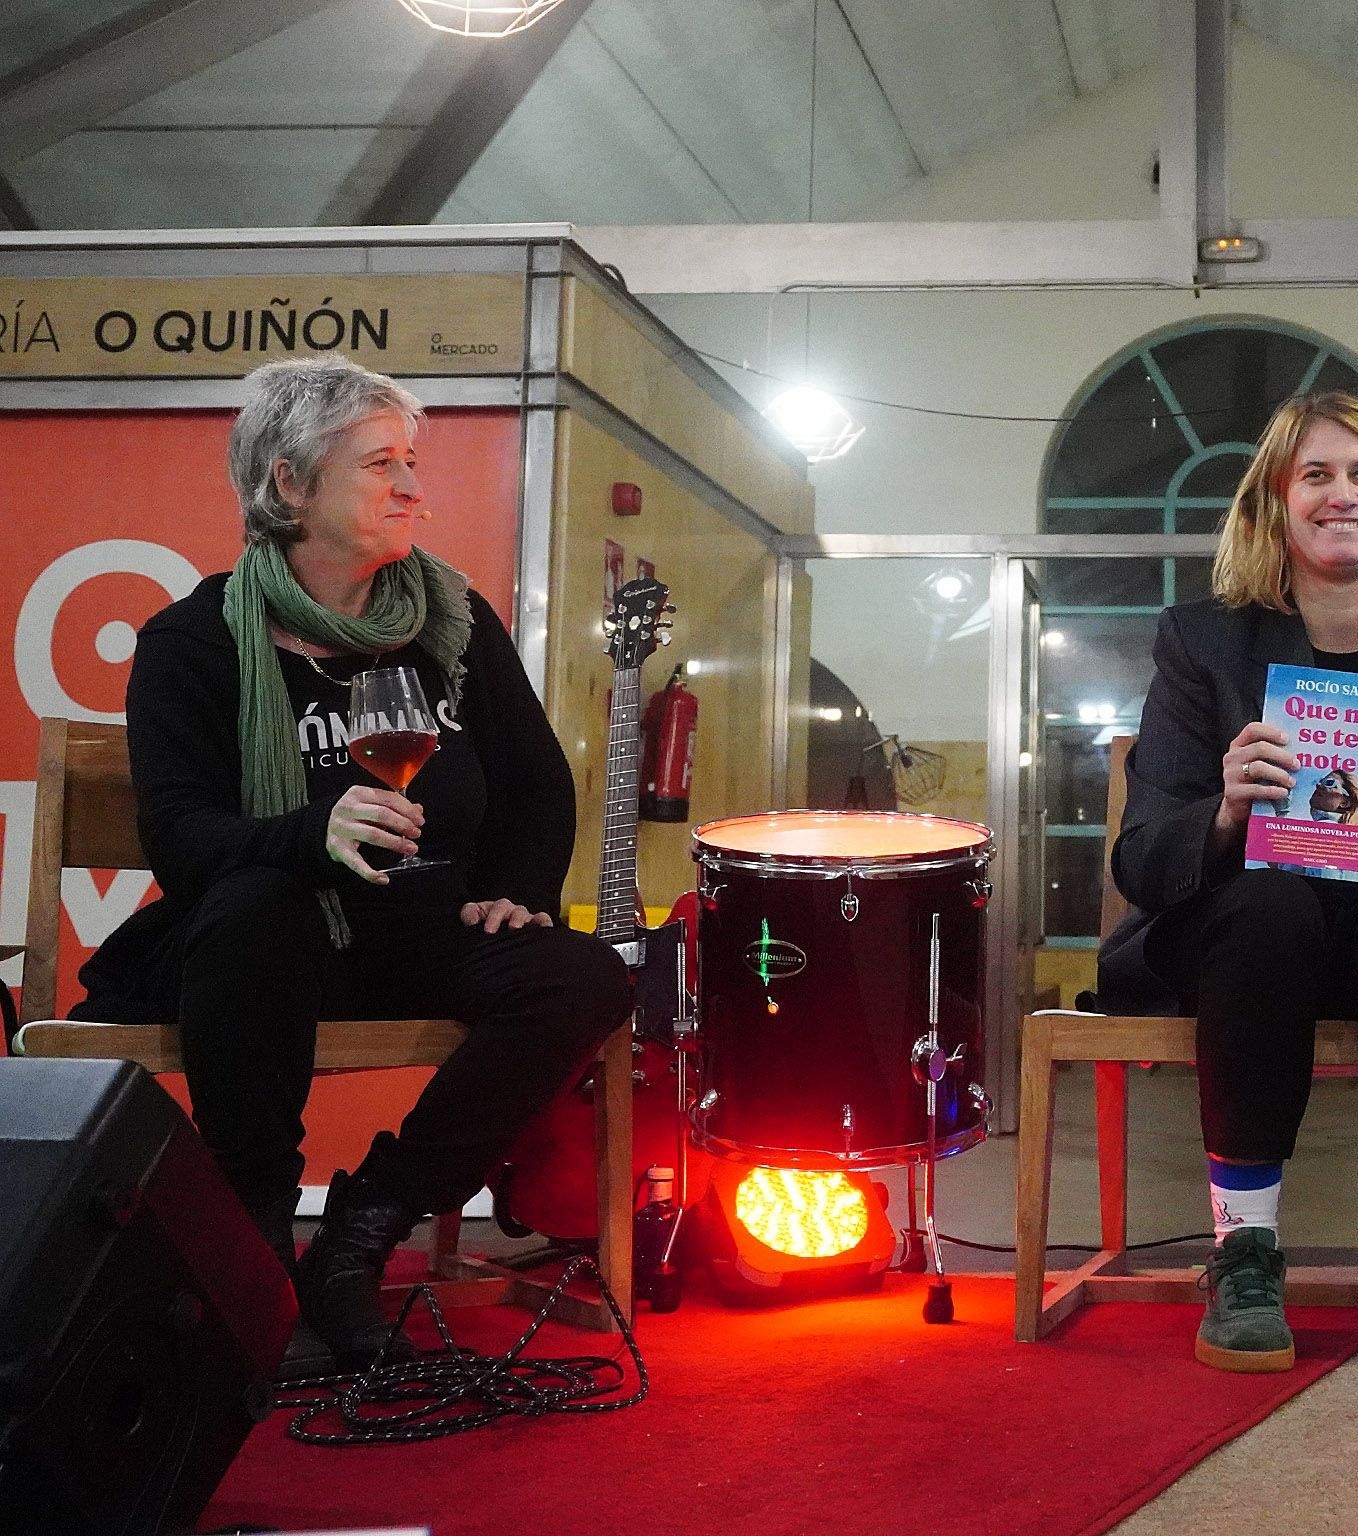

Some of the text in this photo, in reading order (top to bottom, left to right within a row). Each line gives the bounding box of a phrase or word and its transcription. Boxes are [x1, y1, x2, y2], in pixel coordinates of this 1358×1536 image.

[94, 310, 137, 353] O
[153, 296, 389, 354] QUIÑÓN
[430, 344, 499, 356] MERCADO
[1296, 680, 1339, 694] ROCÍO
[1285, 696, 1338, 721] Que
[1298, 728, 1358, 748] se te
[1296, 753, 1357, 773] note
[1265, 822, 1281, 830] UNA
[1281, 824, 1320, 834] LUMINOSA
[1320, 828, 1350, 838] NOVELA
